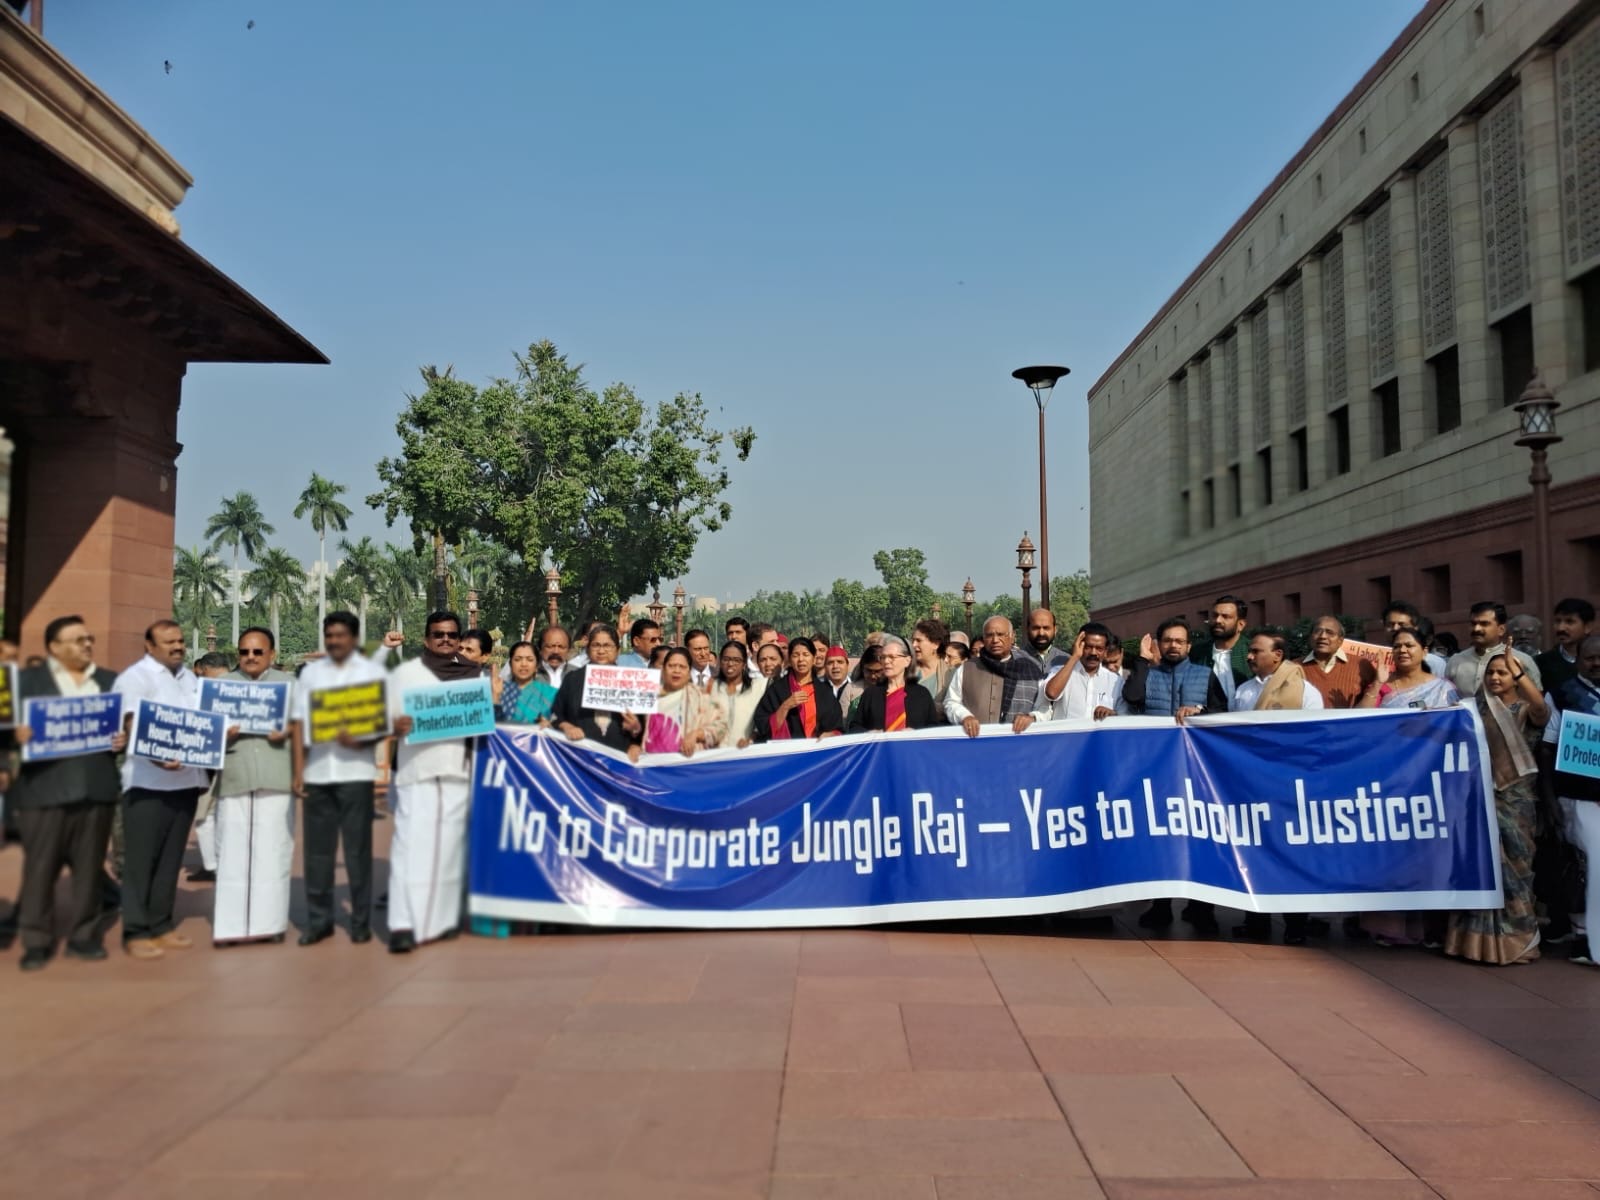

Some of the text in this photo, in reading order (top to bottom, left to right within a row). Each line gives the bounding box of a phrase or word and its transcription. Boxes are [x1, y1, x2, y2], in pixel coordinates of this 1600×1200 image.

[156, 704, 185, 725] Protect
[185, 711, 213, 733] Wages,
[1574, 722, 1585, 740] 29
[1587, 724, 1600, 743] La
[1564, 744, 1570, 761] 0
[558, 805, 592, 859] to
[602, 801, 780, 881] Corporate
[792, 796, 901, 874] Jungle
[912, 792, 967, 867] Raj
[1019, 788, 1087, 850] Yes
[1096, 791, 1134, 841] to
[1142, 778, 1271, 846] Labour
